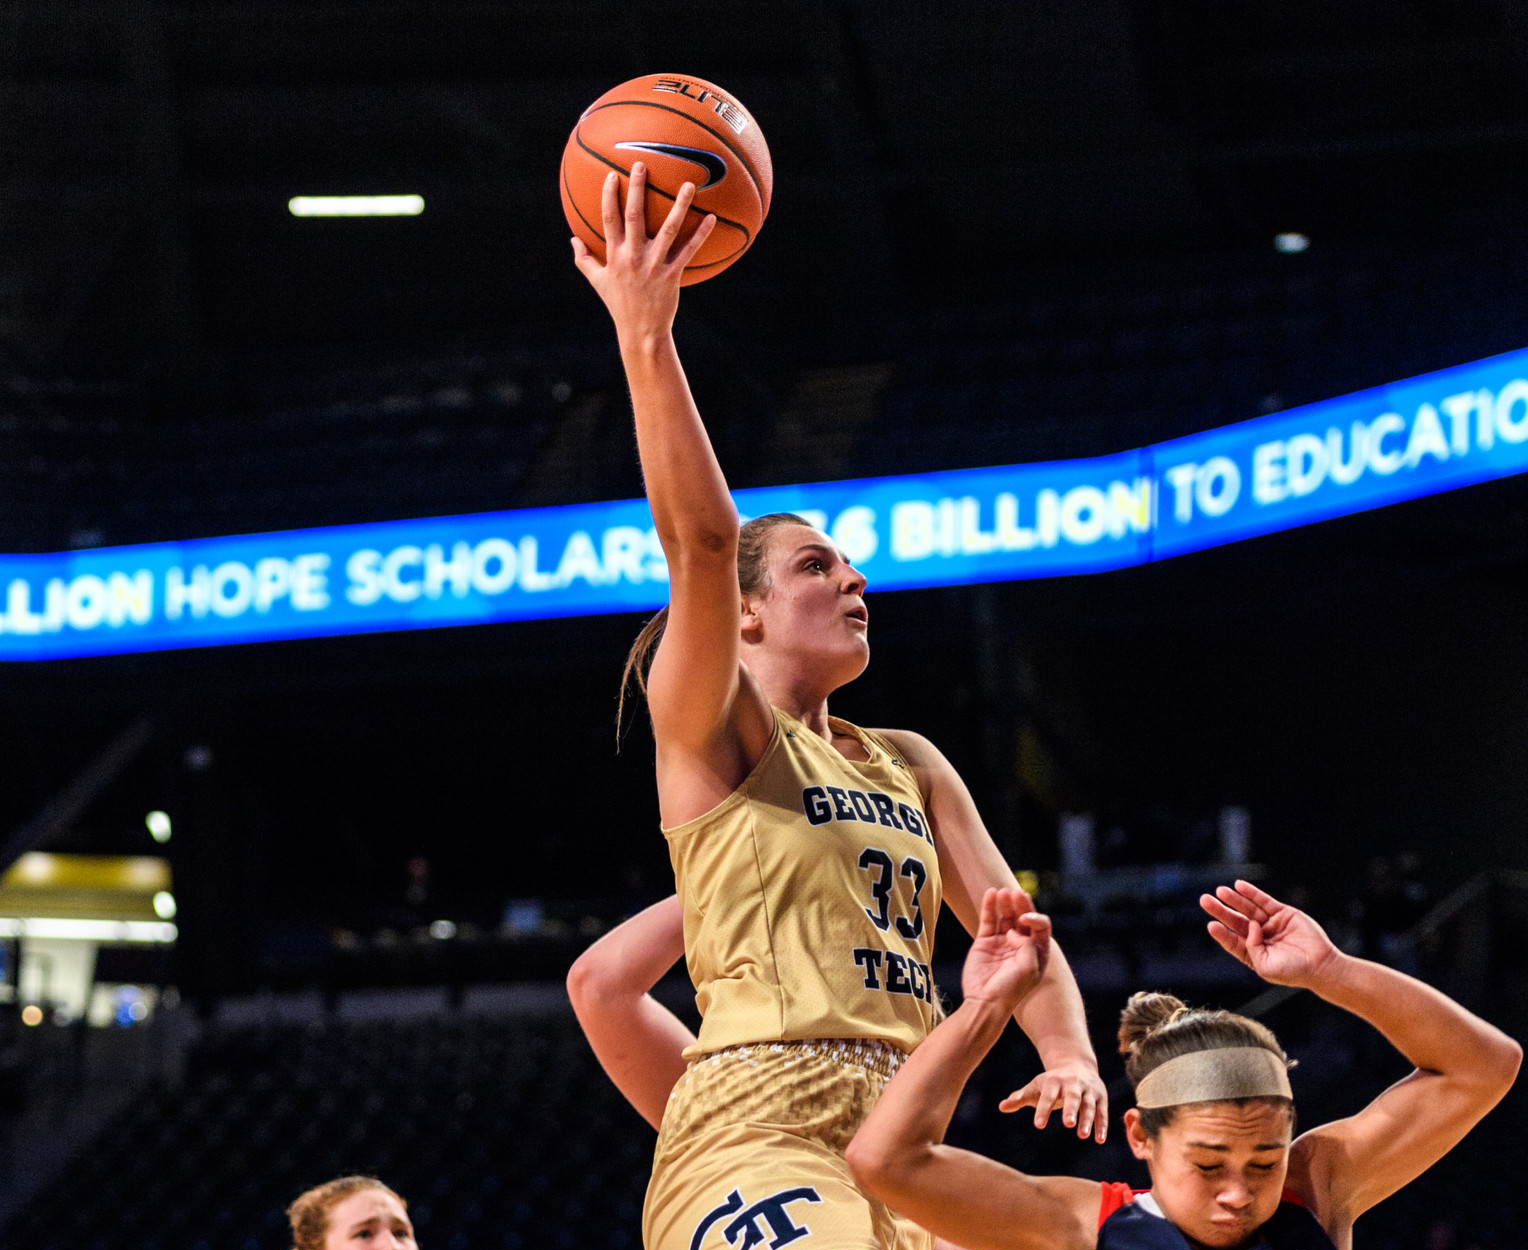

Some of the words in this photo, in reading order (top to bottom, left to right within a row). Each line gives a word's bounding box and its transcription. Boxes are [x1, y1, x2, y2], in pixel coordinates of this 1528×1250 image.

[652, 79, 748, 135] ELITE
[0, 568, 155, 635] LION
[164, 552, 332, 621] HOPE
[889, 475, 1157, 562] BILLION
[1165, 455, 1241, 524] TO
[857, 846, 927, 939] 33
